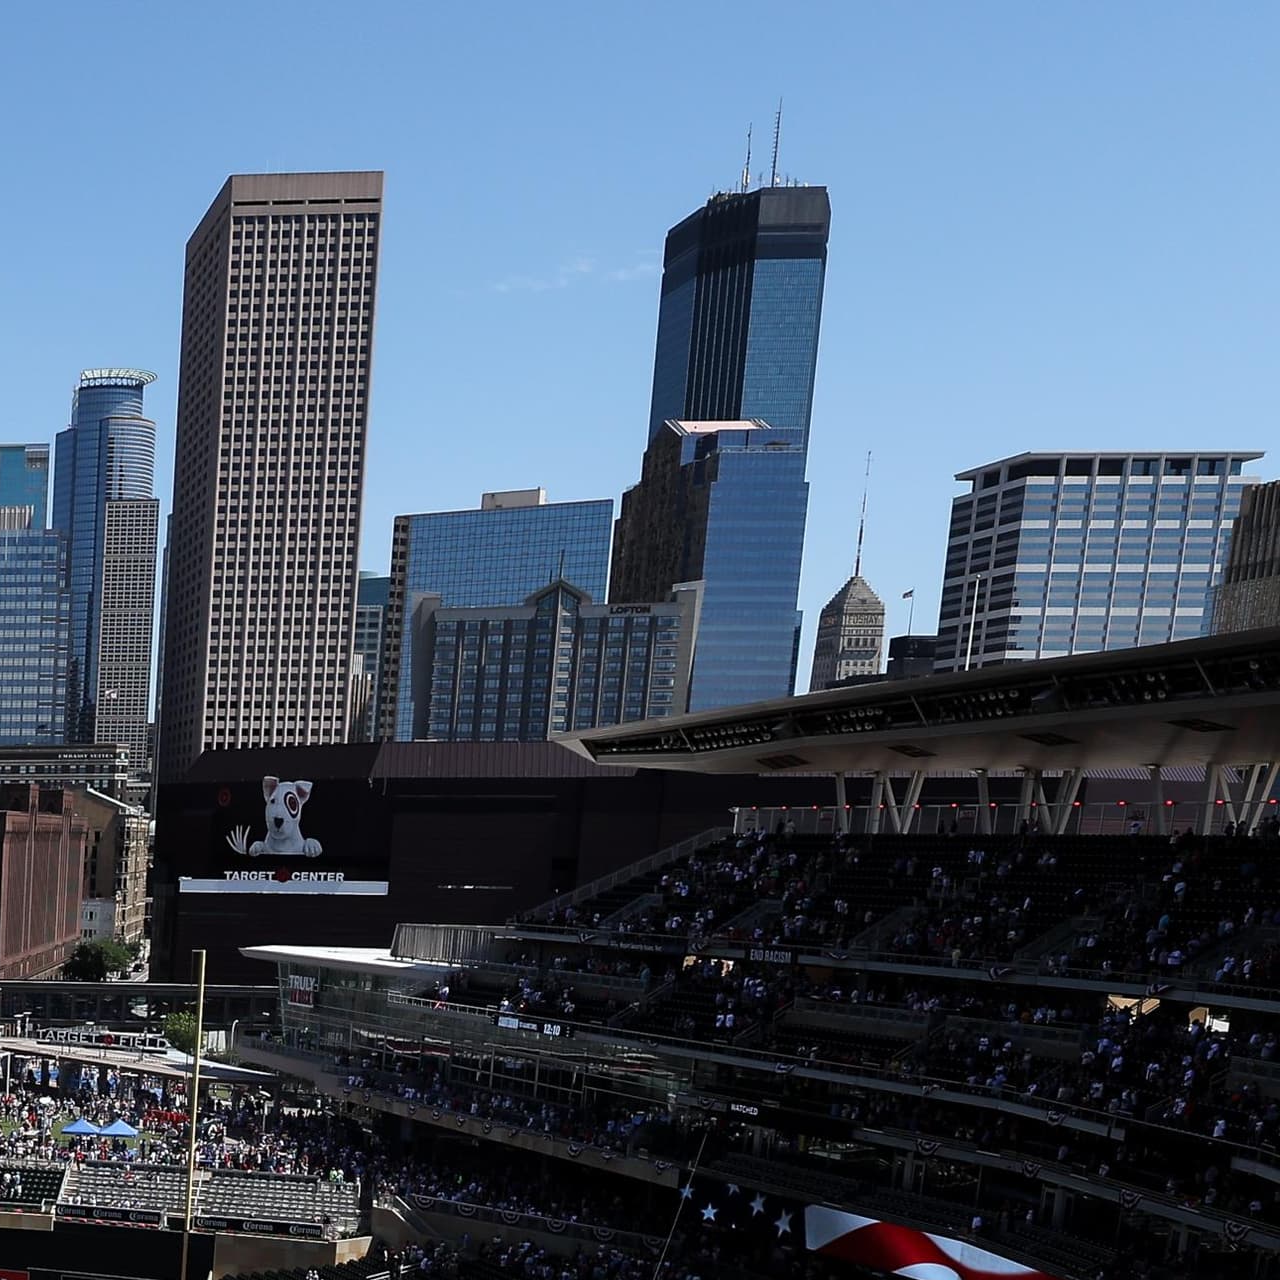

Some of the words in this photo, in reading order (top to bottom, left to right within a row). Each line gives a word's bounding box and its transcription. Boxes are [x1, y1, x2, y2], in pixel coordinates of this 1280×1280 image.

[224, 870, 275, 881] TARGET
[291, 871, 345, 882] CENTER
[37, 1029, 101, 1044] TARGET
[119, 1034, 171, 1048] FIELD
[56, 1204, 87, 1217] Corona
[92, 1208, 123, 1220] Corona
[128, 1211, 159, 1223] Corona
[196, 1216, 228, 1229] Corona
[242, 1220, 274, 1233] Corona
[289, 1224, 321, 1237] Corona
